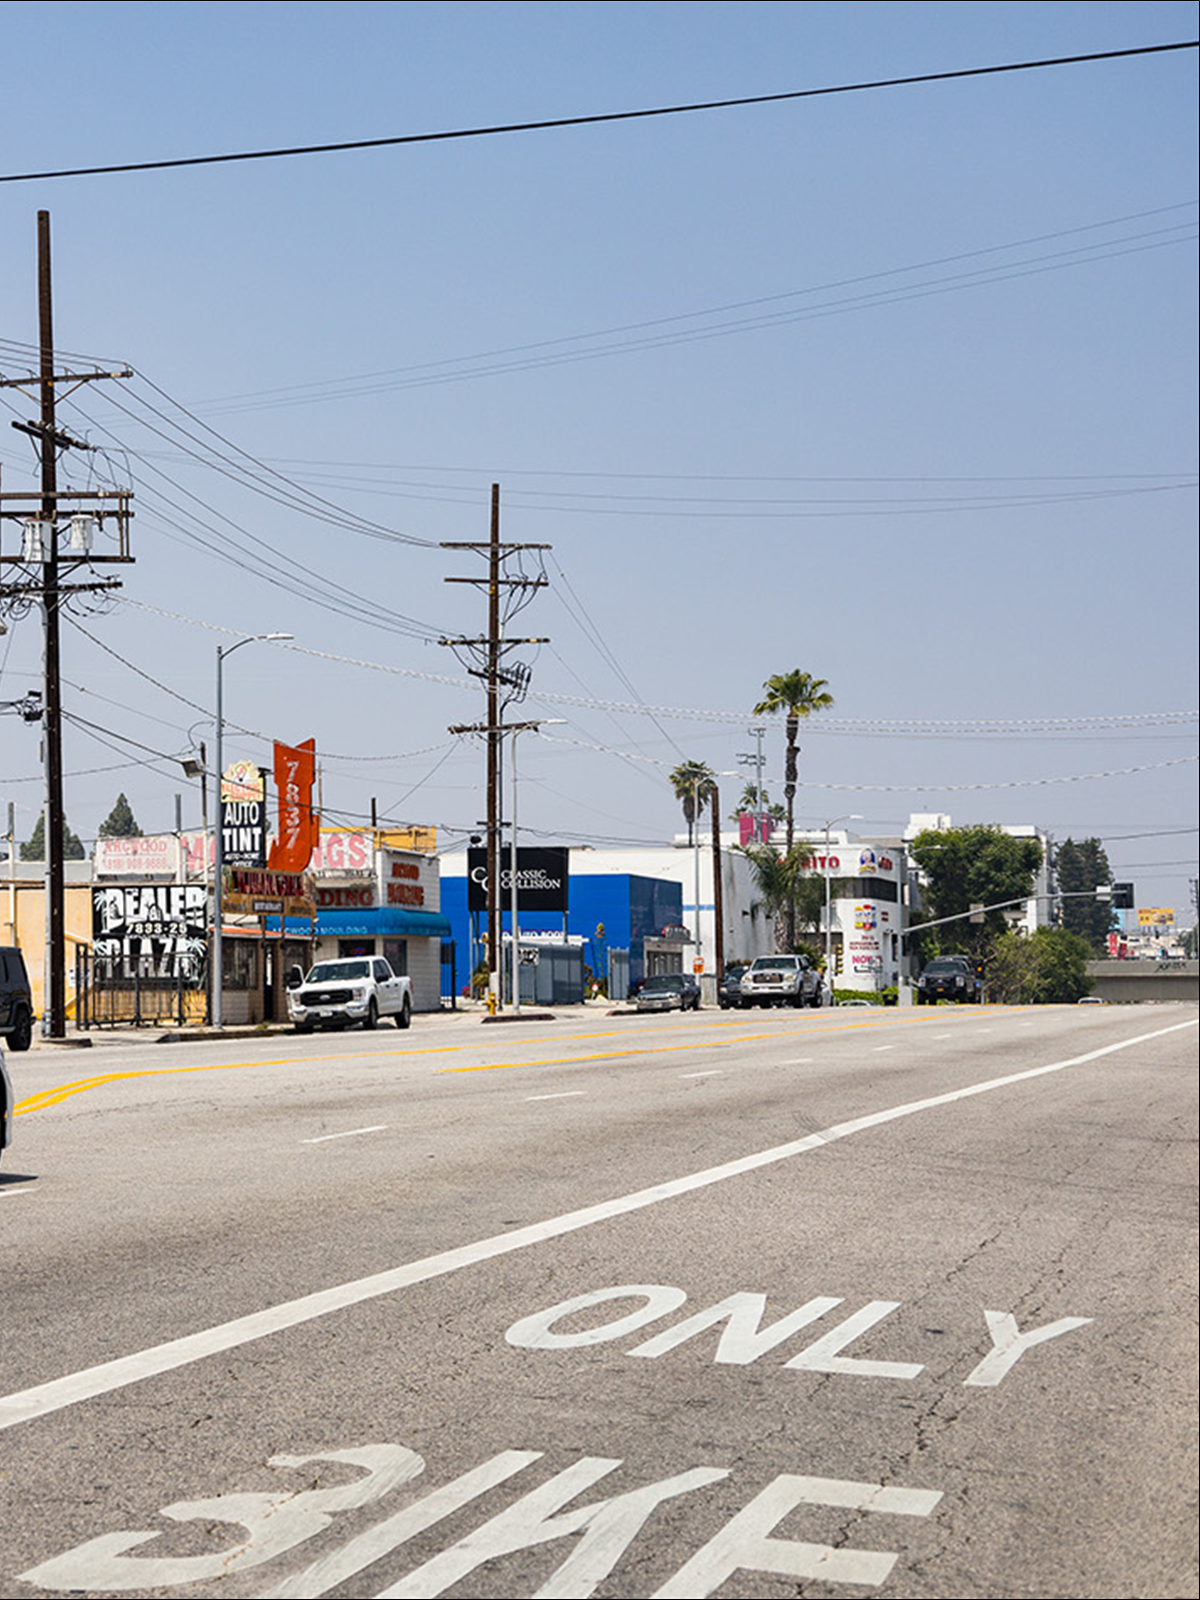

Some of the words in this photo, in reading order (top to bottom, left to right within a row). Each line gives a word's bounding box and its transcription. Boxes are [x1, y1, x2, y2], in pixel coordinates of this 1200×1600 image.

[224, 802, 259, 825] AUTO
[286, 761, 300, 850] 7837
[105, 840, 167, 853] ARCWOOD
[222, 828, 261, 852] TINT
[501, 869, 547, 880] CLASSIC
[501, 879, 560, 890] COLLISION
[125, 922, 187, 934] 7833-25
[106, 938, 192, 978] PLAZA
[505, 1285, 1095, 1387] ONLY
